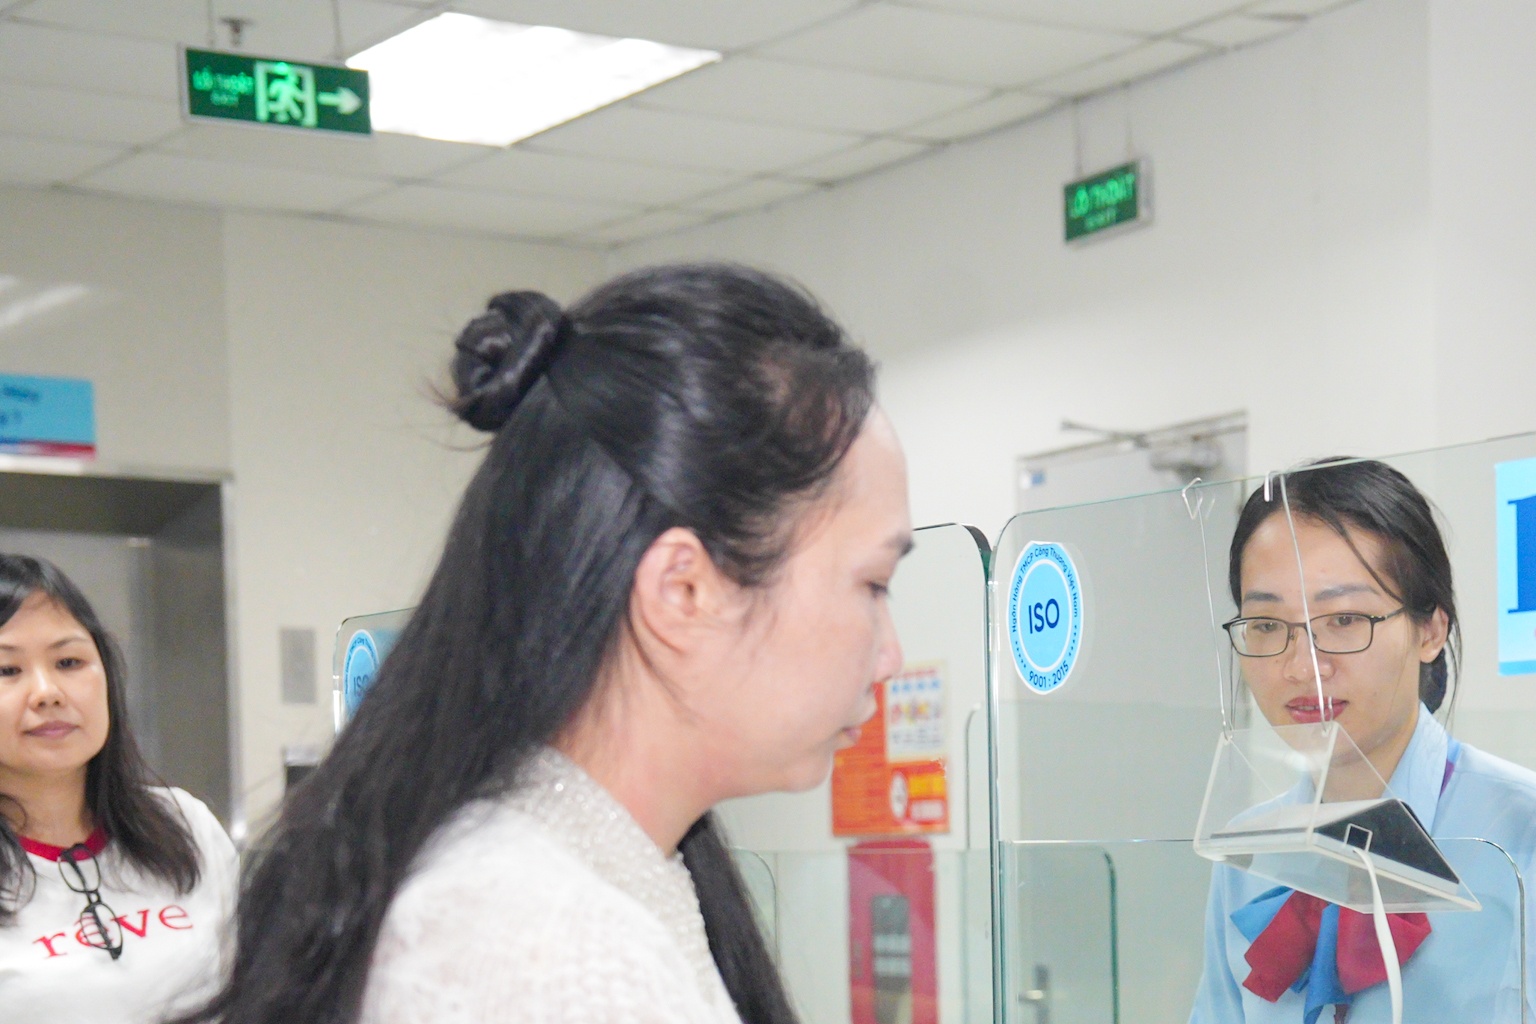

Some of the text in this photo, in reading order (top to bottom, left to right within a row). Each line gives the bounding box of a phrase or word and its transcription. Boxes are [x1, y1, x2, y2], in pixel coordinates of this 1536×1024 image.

[1020, 552, 1034, 574] TMCP
[1034, 546, 1049, 557] Công
[1028, 598, 1060, 634] ISO
[1052, 660, 1069, 685] 2015
